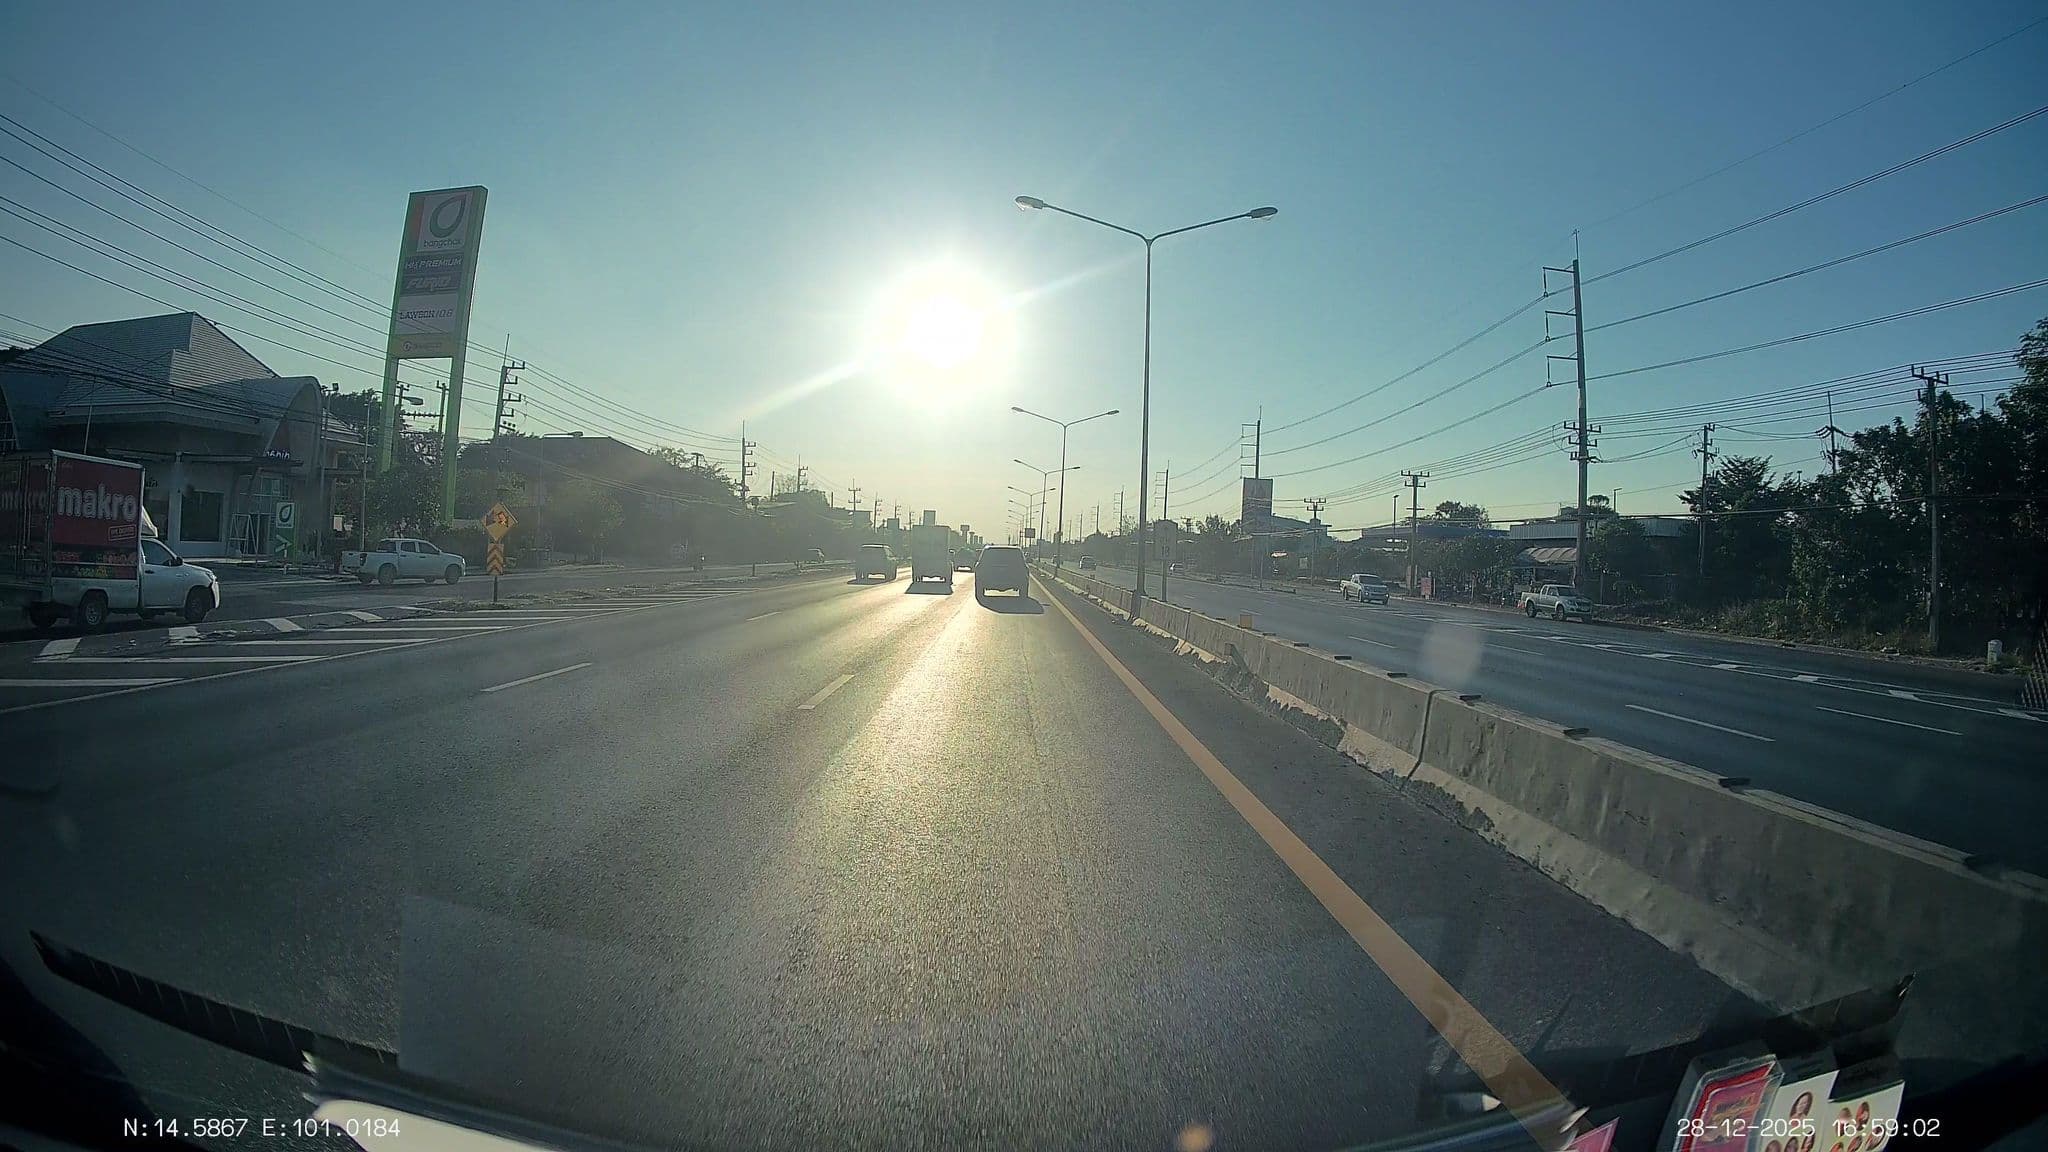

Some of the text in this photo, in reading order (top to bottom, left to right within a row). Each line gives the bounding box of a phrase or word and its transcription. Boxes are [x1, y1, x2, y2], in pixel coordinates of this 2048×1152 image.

[418, 258, 462, 268] PREMIUM
[399, 309, 435, 320] LAWSON
[56, 482, 138, 521] makro
